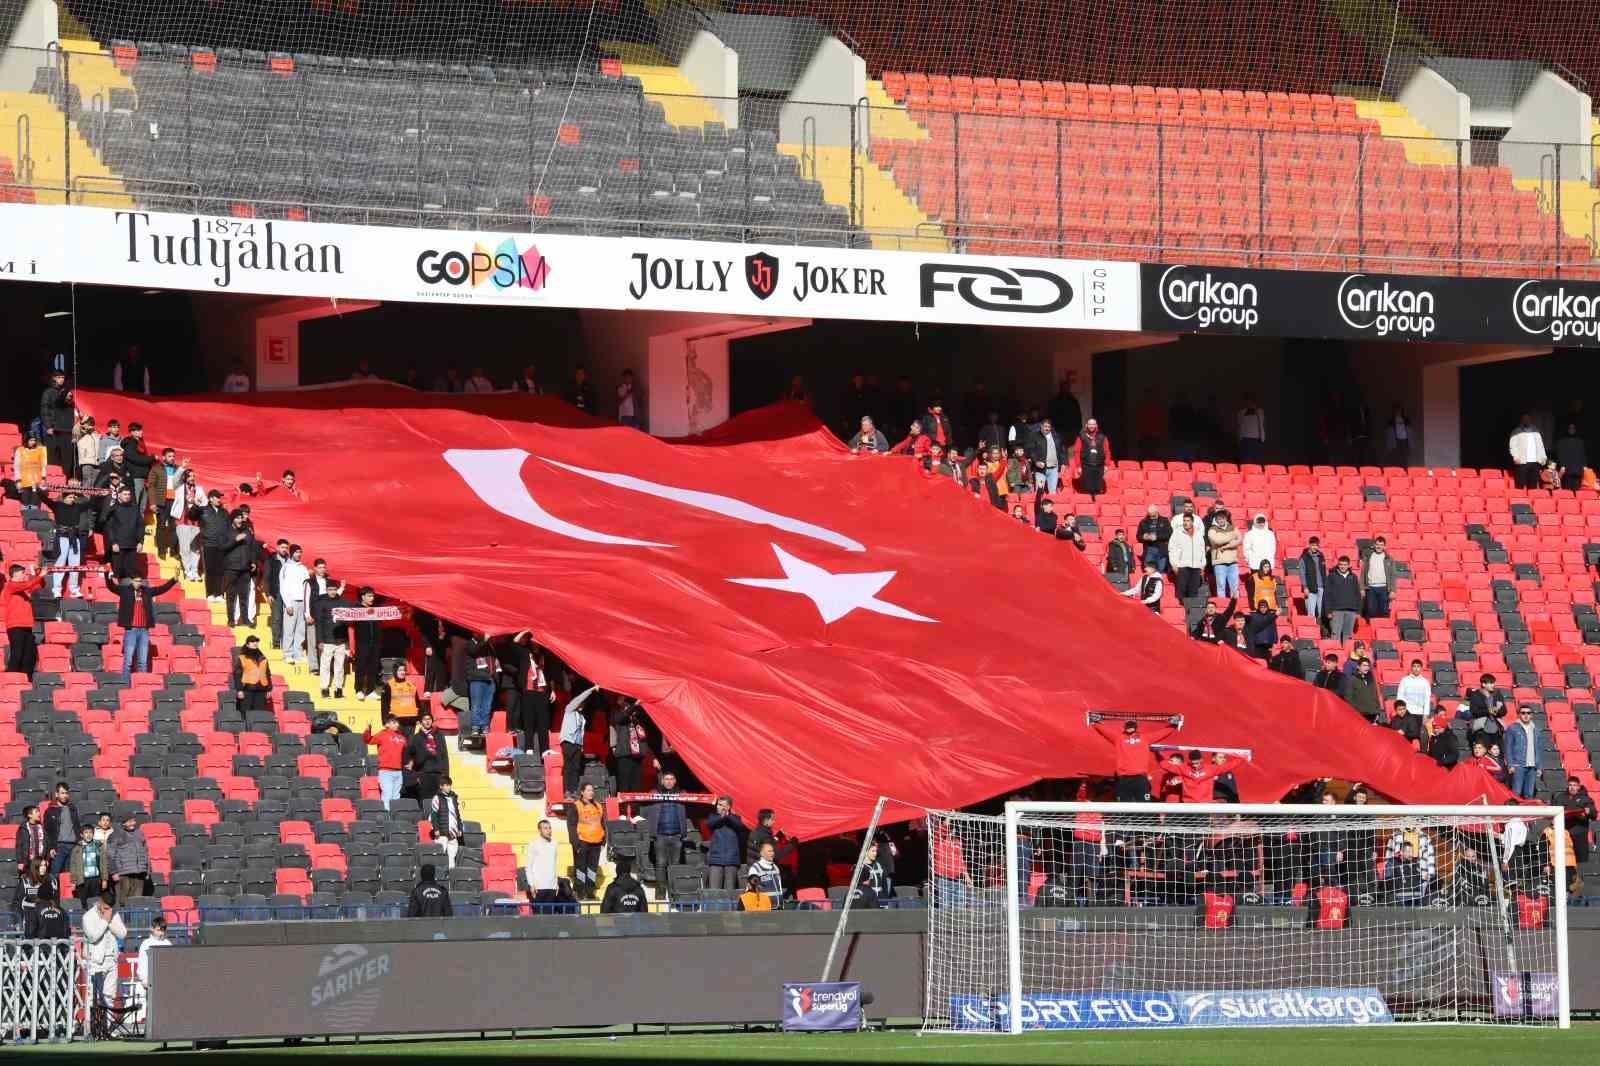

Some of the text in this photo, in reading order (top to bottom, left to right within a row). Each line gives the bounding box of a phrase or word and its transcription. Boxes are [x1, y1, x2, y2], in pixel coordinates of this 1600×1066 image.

[206, 217, 257, 237] 1874
[115, 211, 344, 287] Tudyahan
[416, 249, 546, 289] GOPSM
[629, 252, 733, 300] JOLLY
[793, 261, 887, 302] JOKER
[920, 263, 1074, 314] FGD
[1198, 306, 1258, 331] group
[1376, 314, 1435, 338] group
[1551, 320, 1600, 342] grou
[311, 953, 390, 1007] SARIYER
